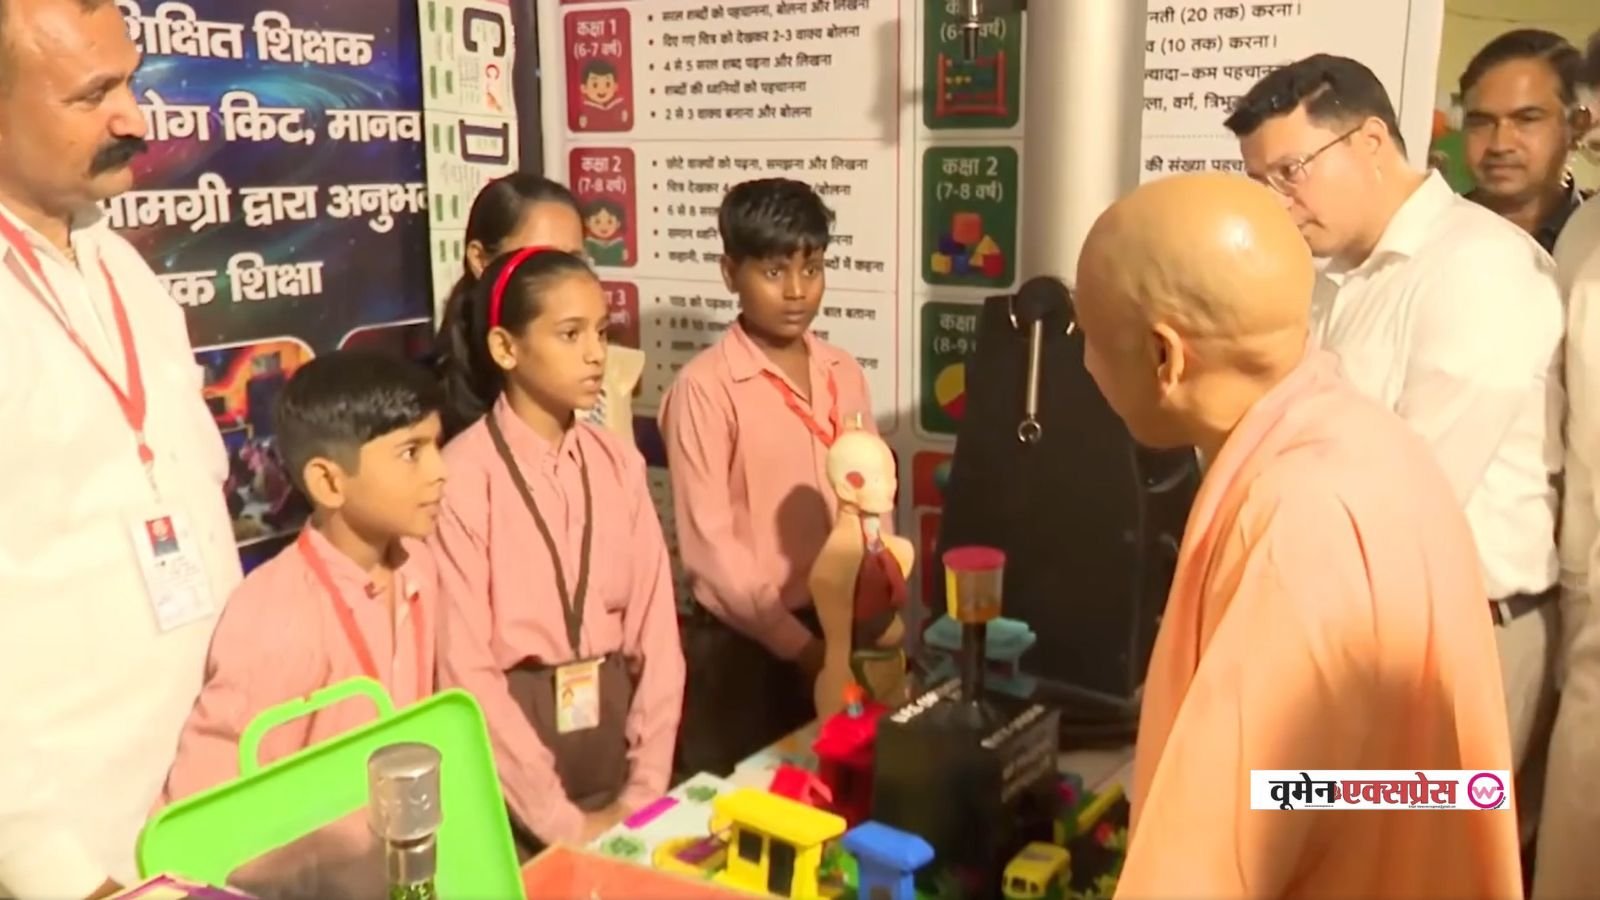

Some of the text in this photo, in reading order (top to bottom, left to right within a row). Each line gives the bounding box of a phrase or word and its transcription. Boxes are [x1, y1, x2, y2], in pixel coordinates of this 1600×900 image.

[1147, 6, 1175, 23] नती
[1181, 7, 1207, 25] (20
[1213, 4, 1245, 21] तक)
[253, 10, 374, 65] शिक्षक
[576, 19, 617, 38] कक्षा 1
[773, 29, 792, 42] 2-3
[826, 24, 860, 39] बोलना
[573, 42, 600, 60] (6-7
[1161, 38, 1185, 55] (10
[1191, 35, 1223, 52] तक)
[663, 61, 671, 72] 4
[686, 61, 692, 72] 5
[796, 52, 832, 66] लिखना
[219, 90, 316, 145] किट,
[326, 109, 421, 141] मानव
[665, 108, 672, 120] 2
[688, 108, 694, 120] 3
[758, 105, 775, 119] और
[780, 105, 811, 119] बोलना
[612, 155, 622, 173] 2
[808, 156, 827, 170] और
[830, 156, 868, 171] लिखना
[942, 157, 999, 178] कक्षा 2
[1145, 155, 1163, 172] की
[1168, 156, 1206, 171] संख्या
[936, 181, 1003, 202] (7-8 वर्ष)
[239, 186, 318, 227] द्वारा
[226, 252, 324, 302] शिक्षा
[823, 306, 841, 319] बात
[845, 307, 876, 321] बताना
[939, 313, 976, 334] कक्षा
[933, 336, 968, 355] (8-9
